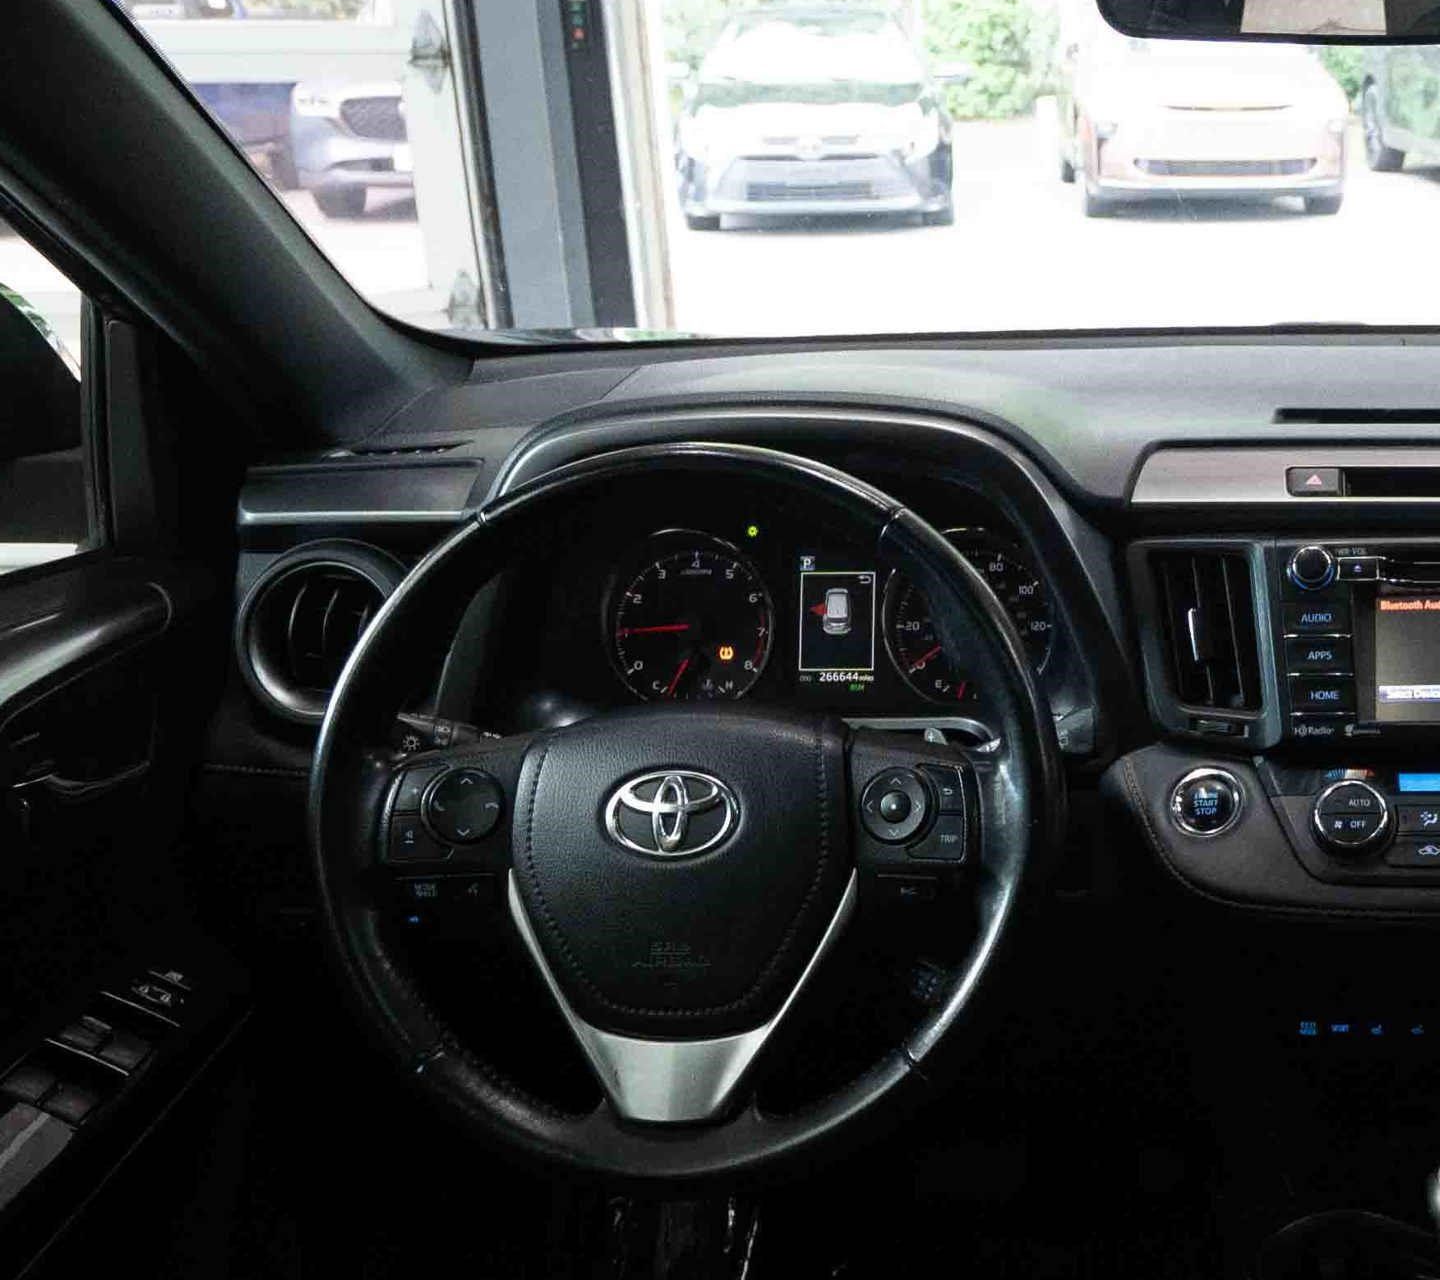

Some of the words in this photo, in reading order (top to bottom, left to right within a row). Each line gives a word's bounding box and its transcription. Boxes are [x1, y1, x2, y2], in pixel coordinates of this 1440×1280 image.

[1017, 585, 1034, 596] 100
[1379, 599, 1423, 610] Bluetooth
[1301, 612, 1333, 623] AUDIO
[903, 620, 921, 632] 20
[1307, 651, 1333, 660] APPS
[819, 671, 859, 682] 266644
[1310, 690, 1340, 700] HOME
[1192, 799, 1218, 808] START
[1348, 798, 1371, 807] AUTO
[1195, 808, 1217, 817] STOP
[1350, 820, 1366, 829] OFF
[939, 834, 959, 844] TRIP
